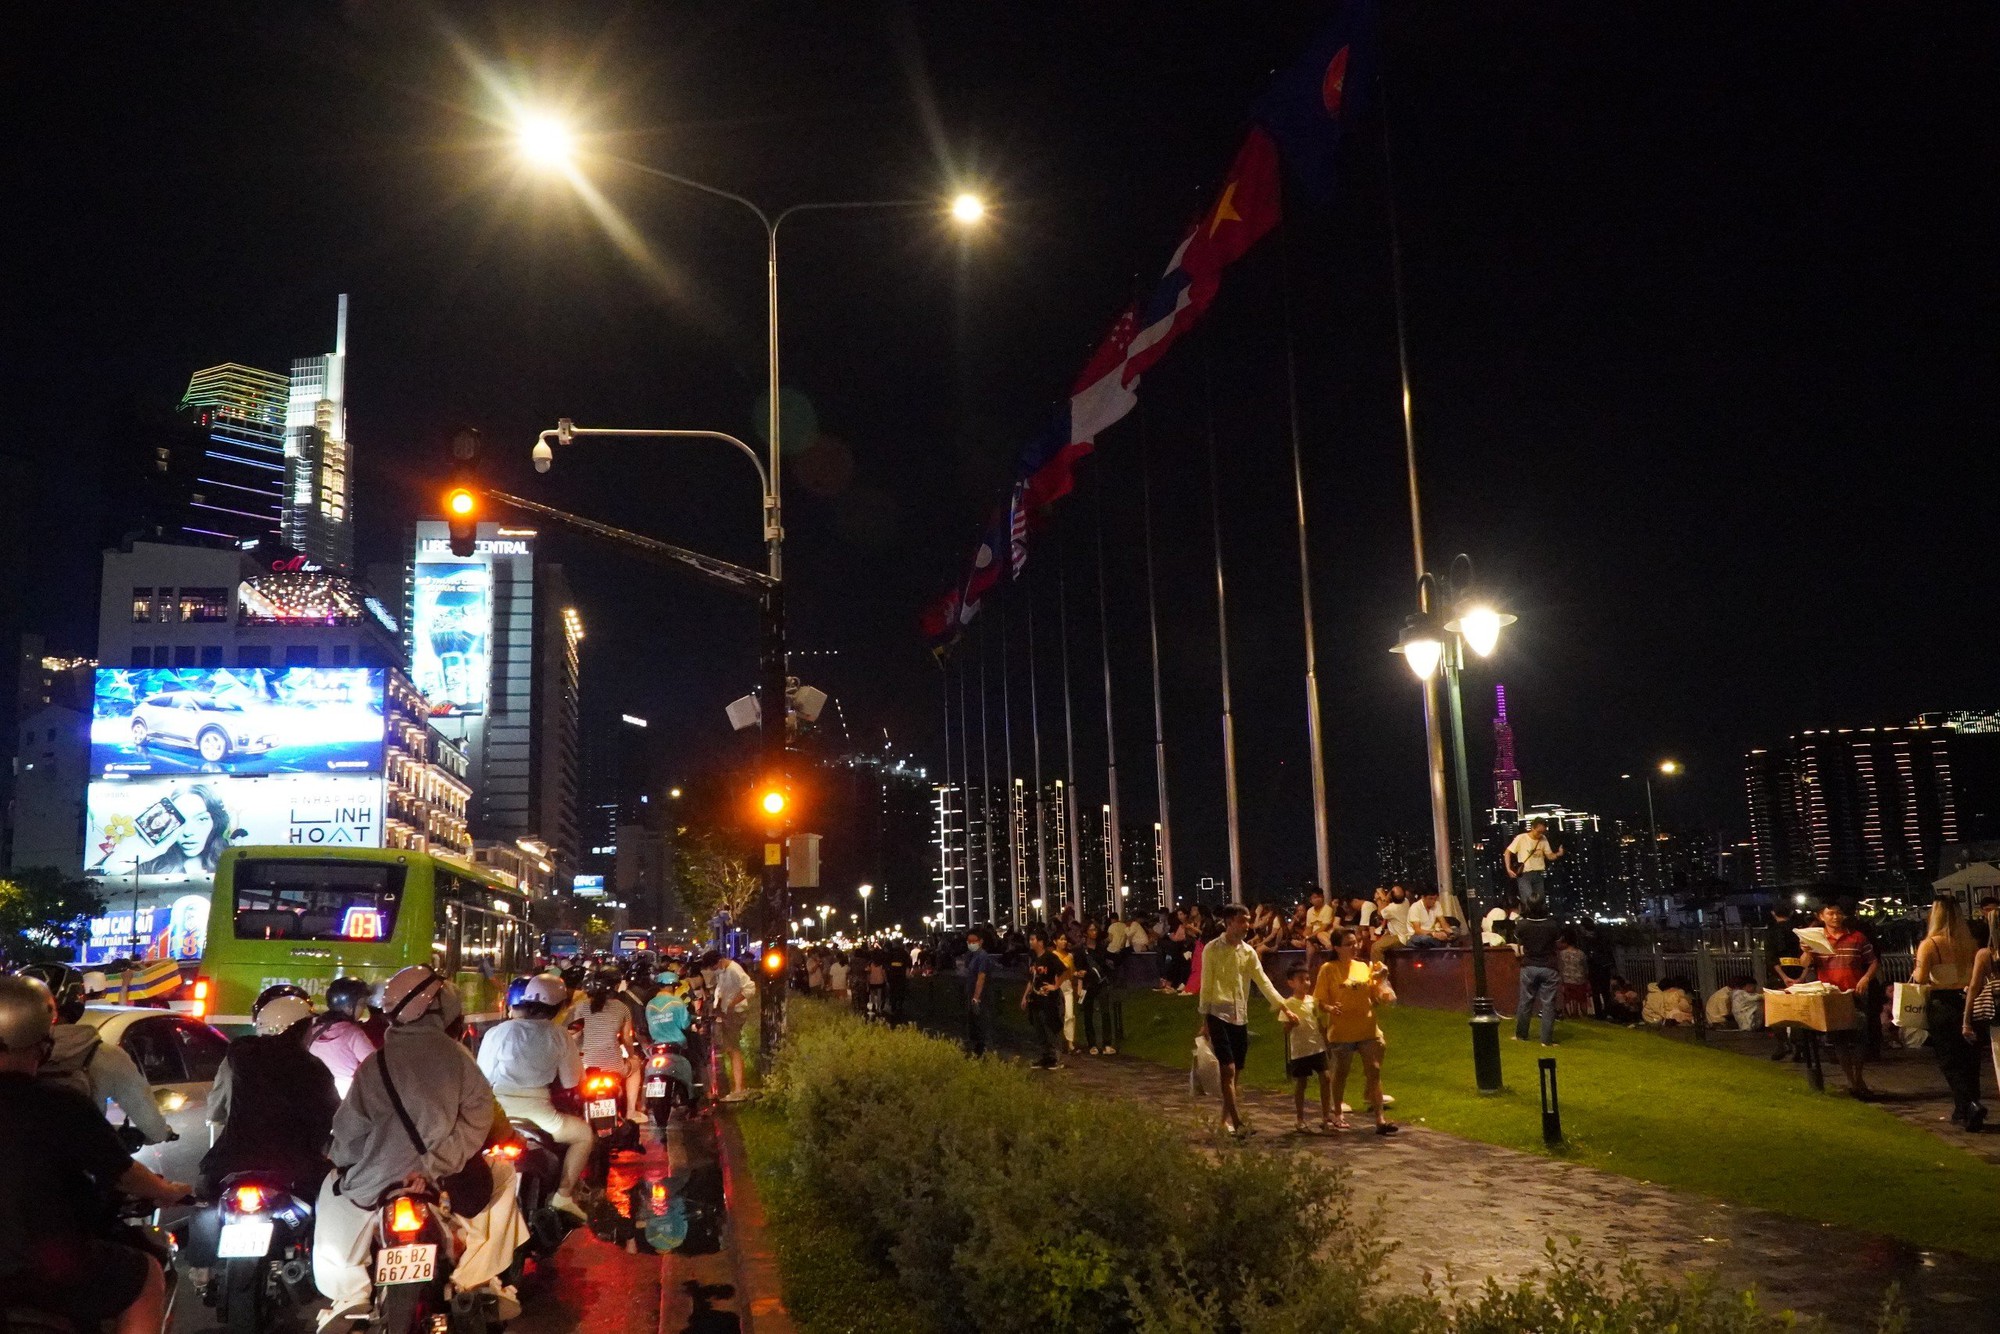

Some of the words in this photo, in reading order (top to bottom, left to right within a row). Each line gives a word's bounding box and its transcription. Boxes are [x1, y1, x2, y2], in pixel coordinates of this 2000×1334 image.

[474, 540, 530, 555] CENTRAL
[291, 808, 371, 824] LINH
[349, 913, 376, 938] 03
[387, 1247, 427, 1265] 86-B2
[379, 1263, 431, 1282] 667.28
